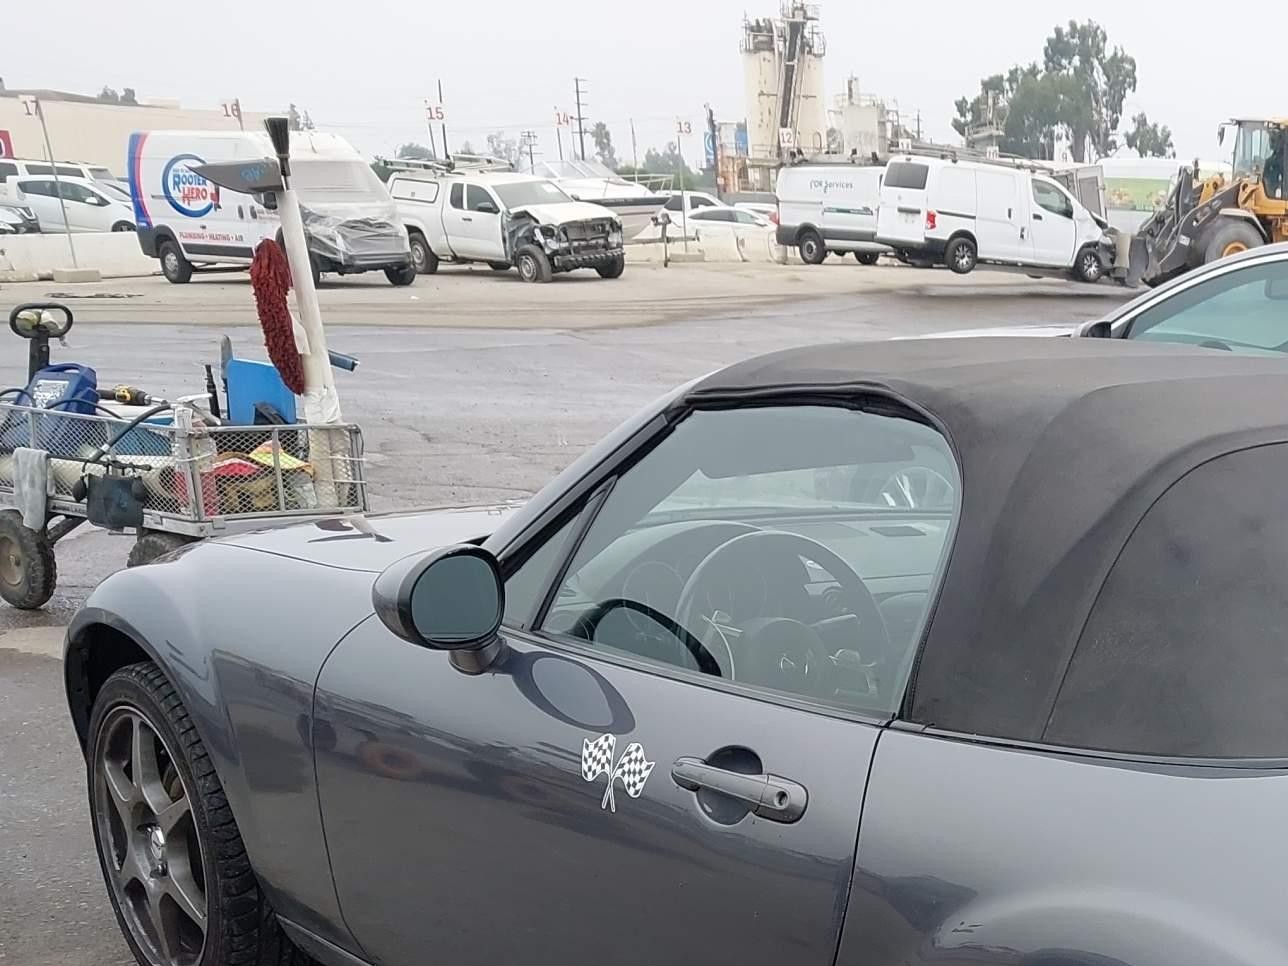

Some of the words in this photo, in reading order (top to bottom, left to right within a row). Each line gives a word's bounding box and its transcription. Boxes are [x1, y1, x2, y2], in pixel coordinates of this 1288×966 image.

[22, 99, 39, 116] 17
[426, 106, 445, 120] 15
[556, 113, 570, 126] 14
[677, 121, 692, 134] 13
[781, 131, 793, 144] 12
[173, 173, 208, 193] ROOTER
[182, 186, 208, 206] HERO
